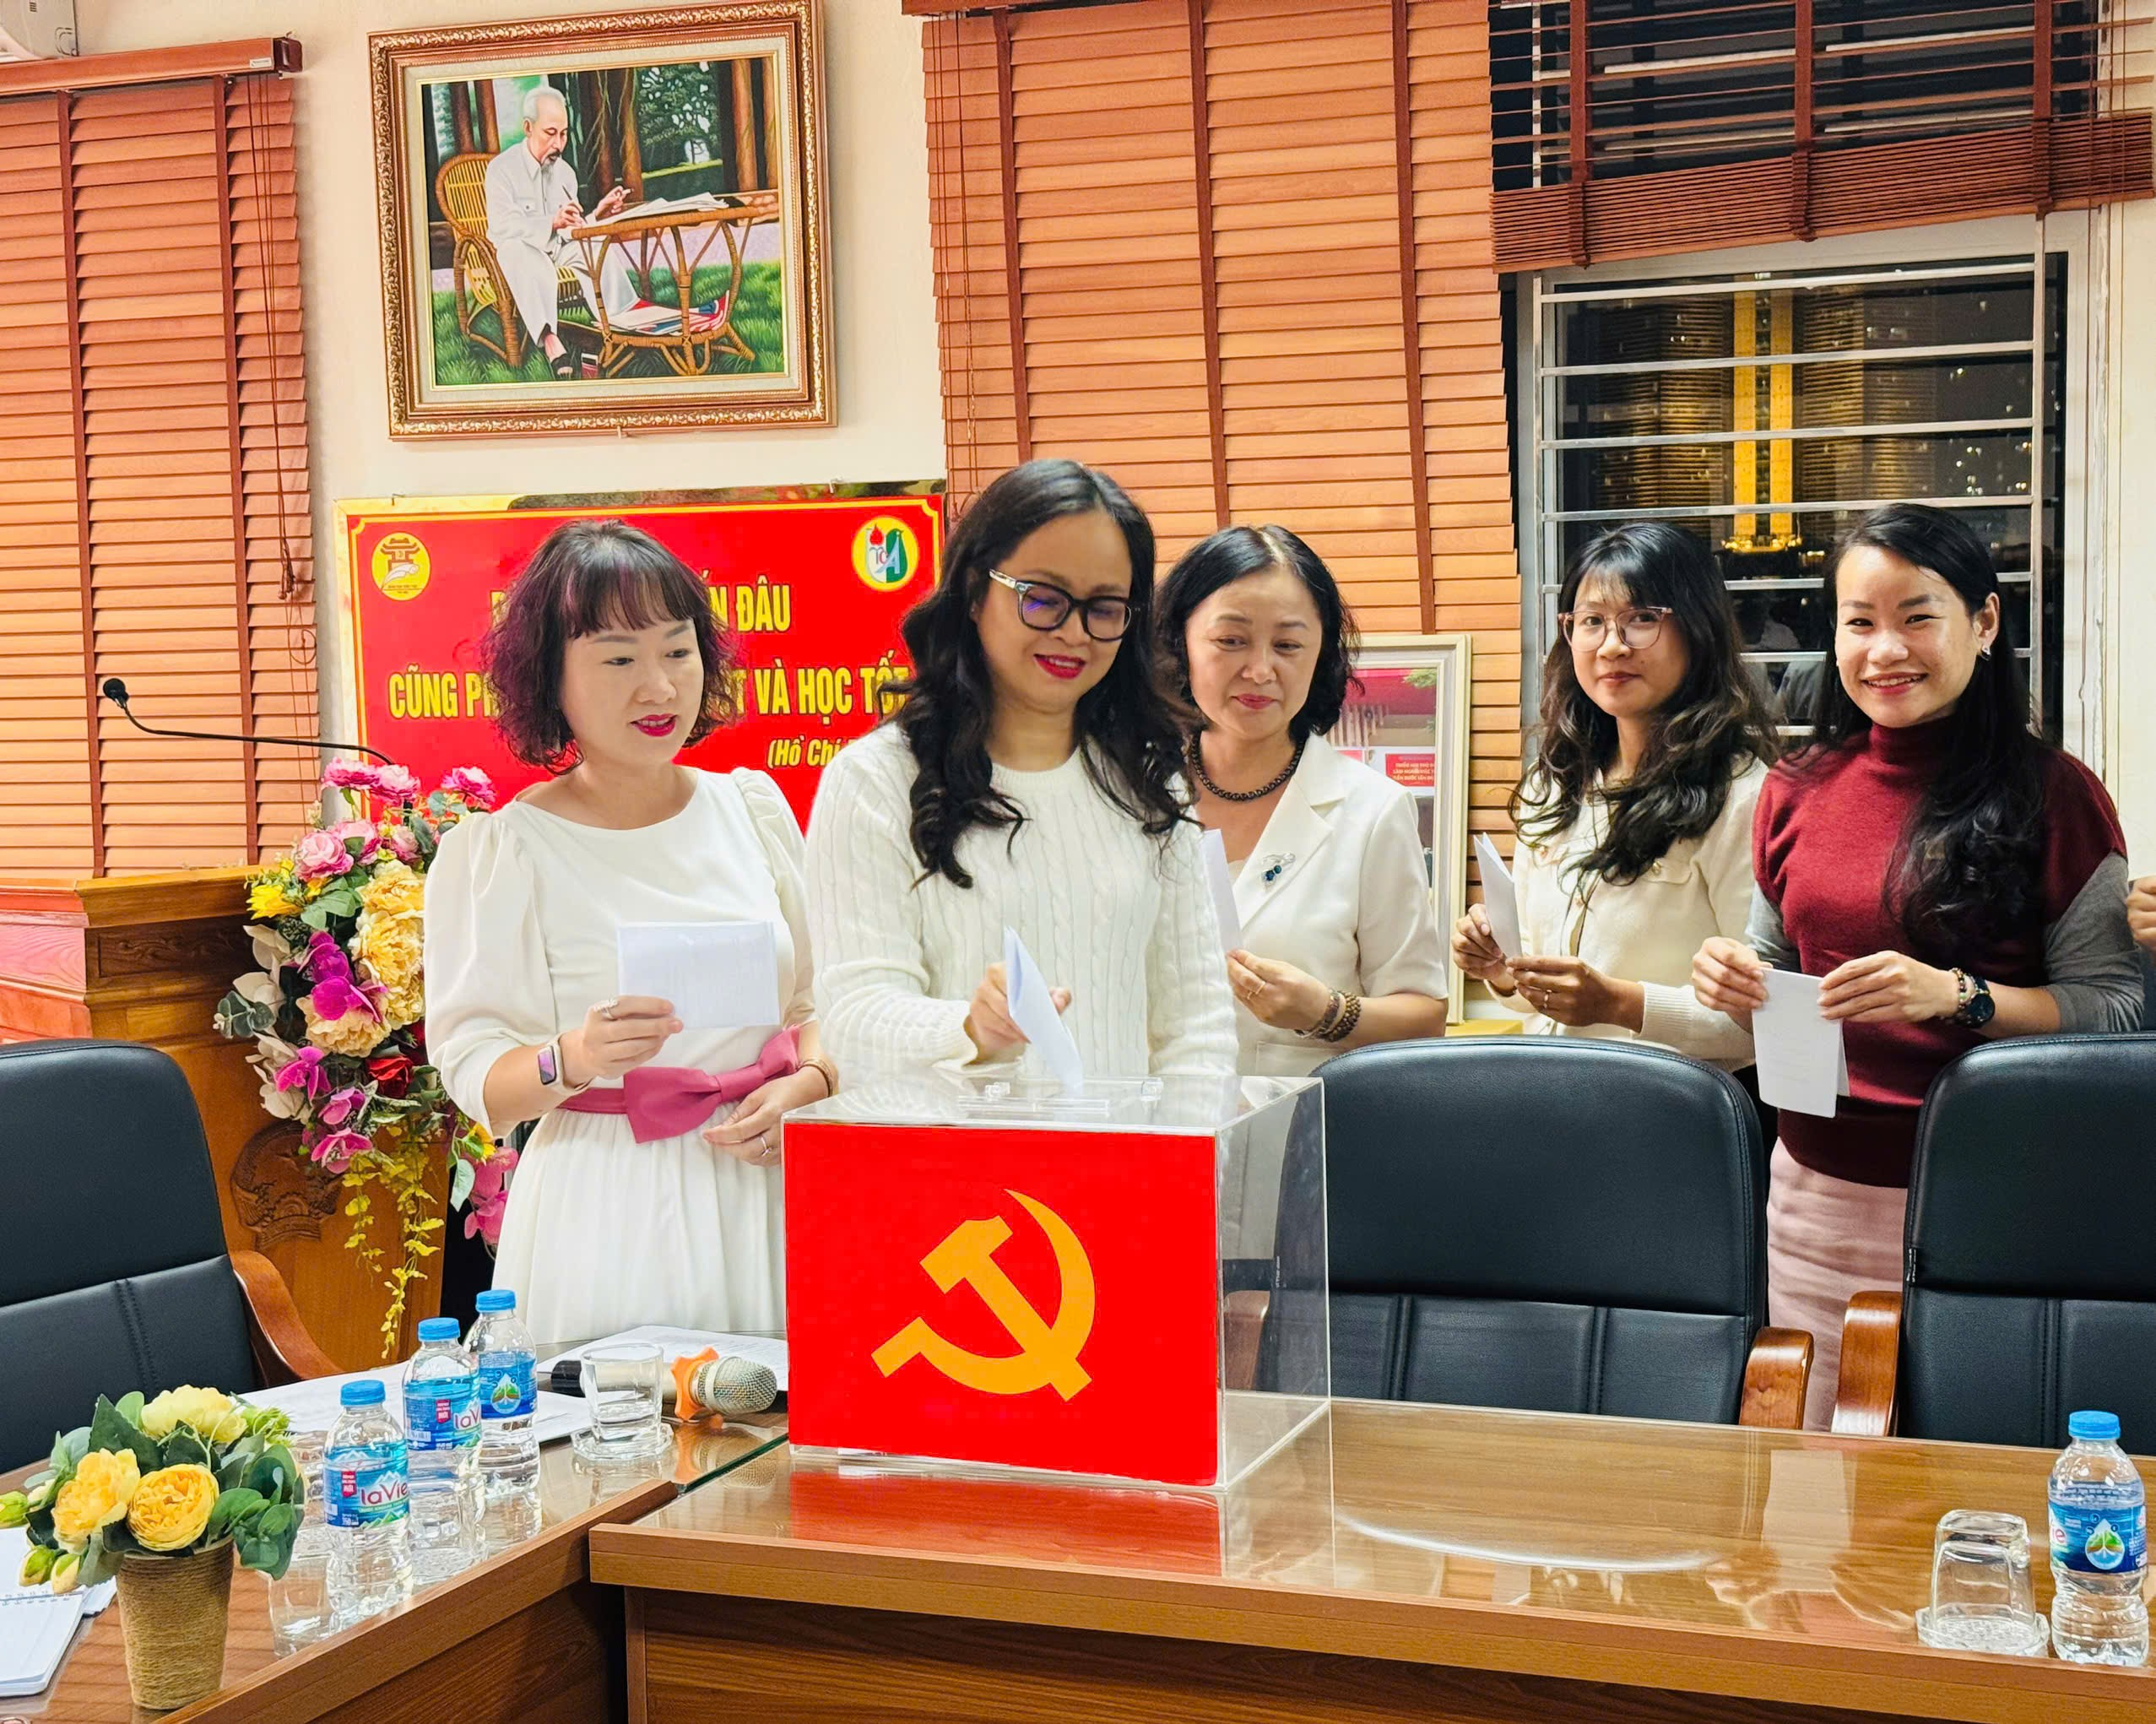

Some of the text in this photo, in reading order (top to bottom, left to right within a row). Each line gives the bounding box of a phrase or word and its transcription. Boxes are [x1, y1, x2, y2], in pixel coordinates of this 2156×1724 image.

[735, 573, 791, 632] ĐÂU
[388, 664, 459, 718] CŨNG
[754, 658, 791, 714] VÀ
[797, 667, 853, 725] HỌC
[767, 735, 804, 769] (Hồ
